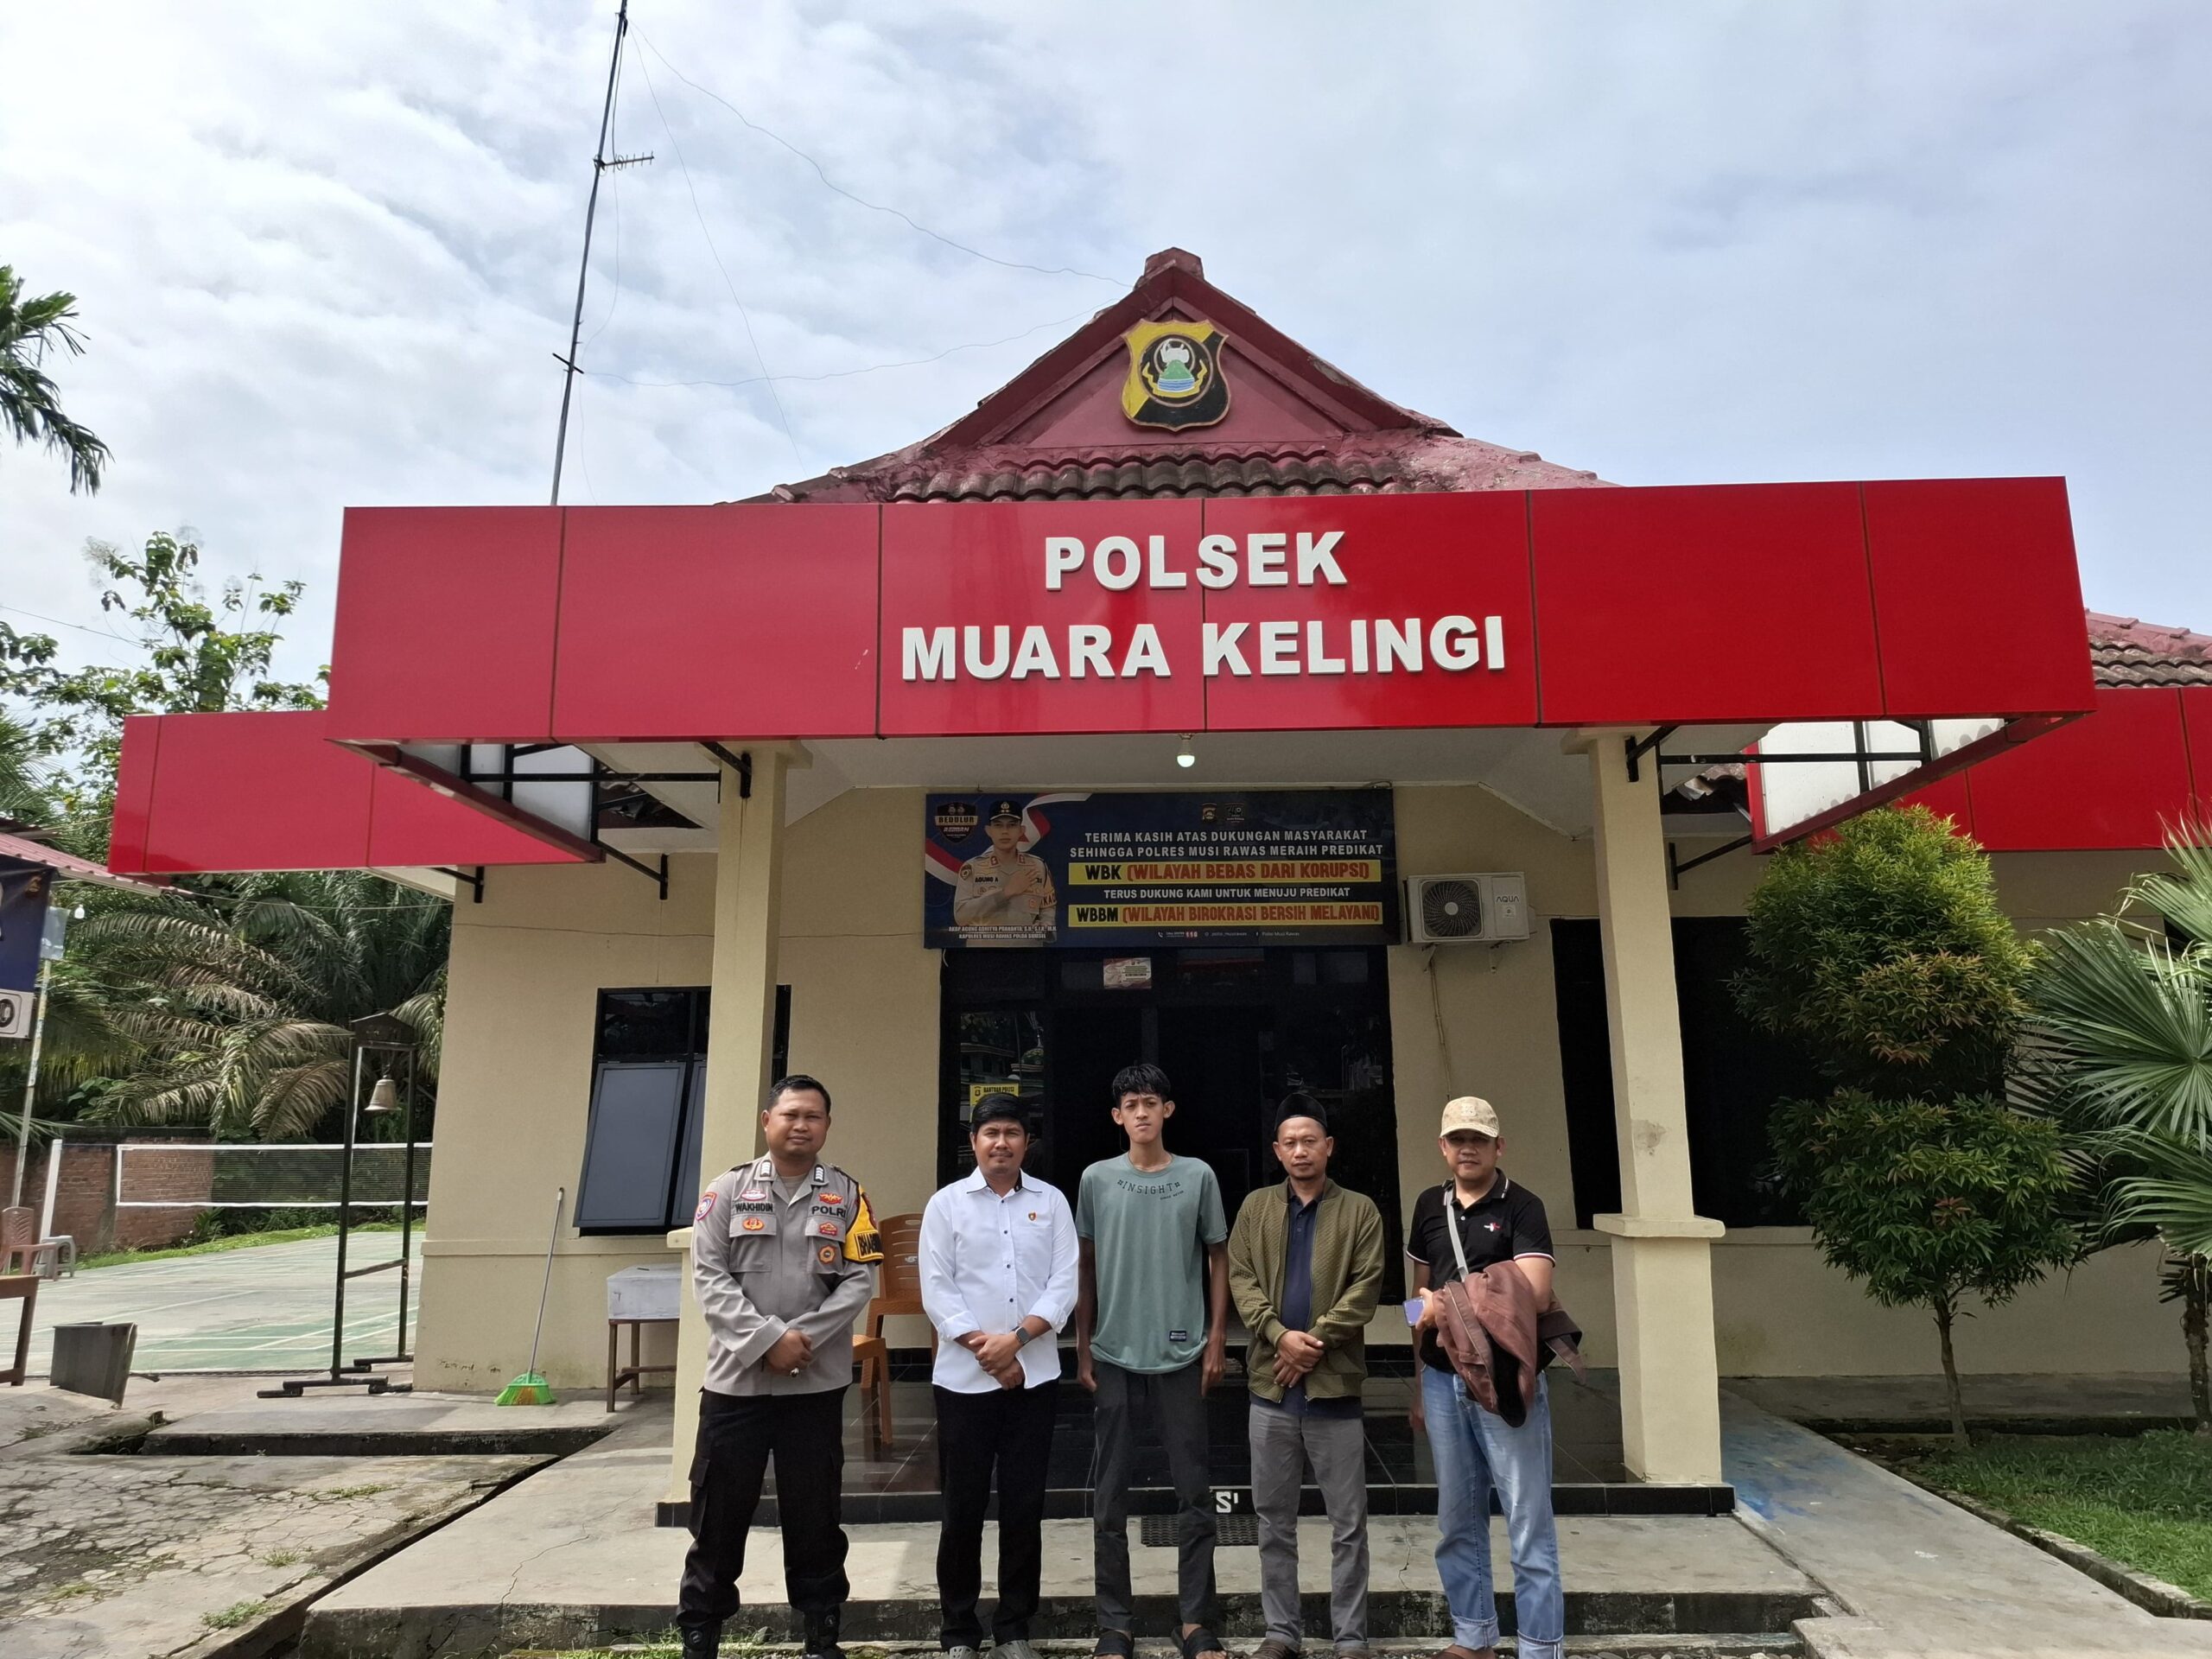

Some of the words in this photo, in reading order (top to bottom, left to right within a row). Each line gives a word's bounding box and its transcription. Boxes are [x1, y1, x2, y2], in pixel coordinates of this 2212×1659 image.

[1046, 531, 1348, 592] POLSEK
[901, 623, 1172, 681] MUARA
[1202, 614, 1506, 677] KELINGI
[1085, 832, 1132, 842] TERIMA
[1135, 832, 1173, 842] KASIH
[1176, 831, 1208, 842] ATAS
[1211, 830, 1281, 842] DUKUNGAN
[1284, 830, 1368, 841] MASYARAKAT
[1070, 847, 1134, 857] SEHINGGA
[1137, 846, 1185, 857] POLRES
[1188, 846, 1219, 856] MUSI
[1224, 846, 1266, 856] RAWAS
[1269, 845, 1318, 855] MERAIH
[1321, 844, 1383, 855] PREDIKAT
[1085, 864, 1122, 880] WBK
[1127, 864, 1201, 881] (WILAYAH
[1205, 863, 1255, 879] BEBAS
[1261, 862, 1295, 879] DARI
[1300, 862, 1370, 880] KORUPSI)
[1103, 889, 1137, 899] TERUS
[1140, 889, 1184, 899] DUKUNG
[1186, 888, 1212, 898] KAMI
[1215, 888, 1251, 898] UNTUK
[1254, 887, 1297, 897] MENUJU
[1300, 887, 1351, 897] PREDIKAT
[1077, 907, 1119, 923] WBBM
[1122, 906, 1185, 923] (WILAYAH
[1189, 906, 1257, 921] BIROKRASI
[1261, 906, 1306, 921] BERSIH
[1310, 905, 1380, 922] MELAYANI)
[1122, 1180, 1173, 1195] INSIGHT
[735, 1202, 773, 1213] WAKHIDIN
[811, 1205, 846, 1218] POLRI
